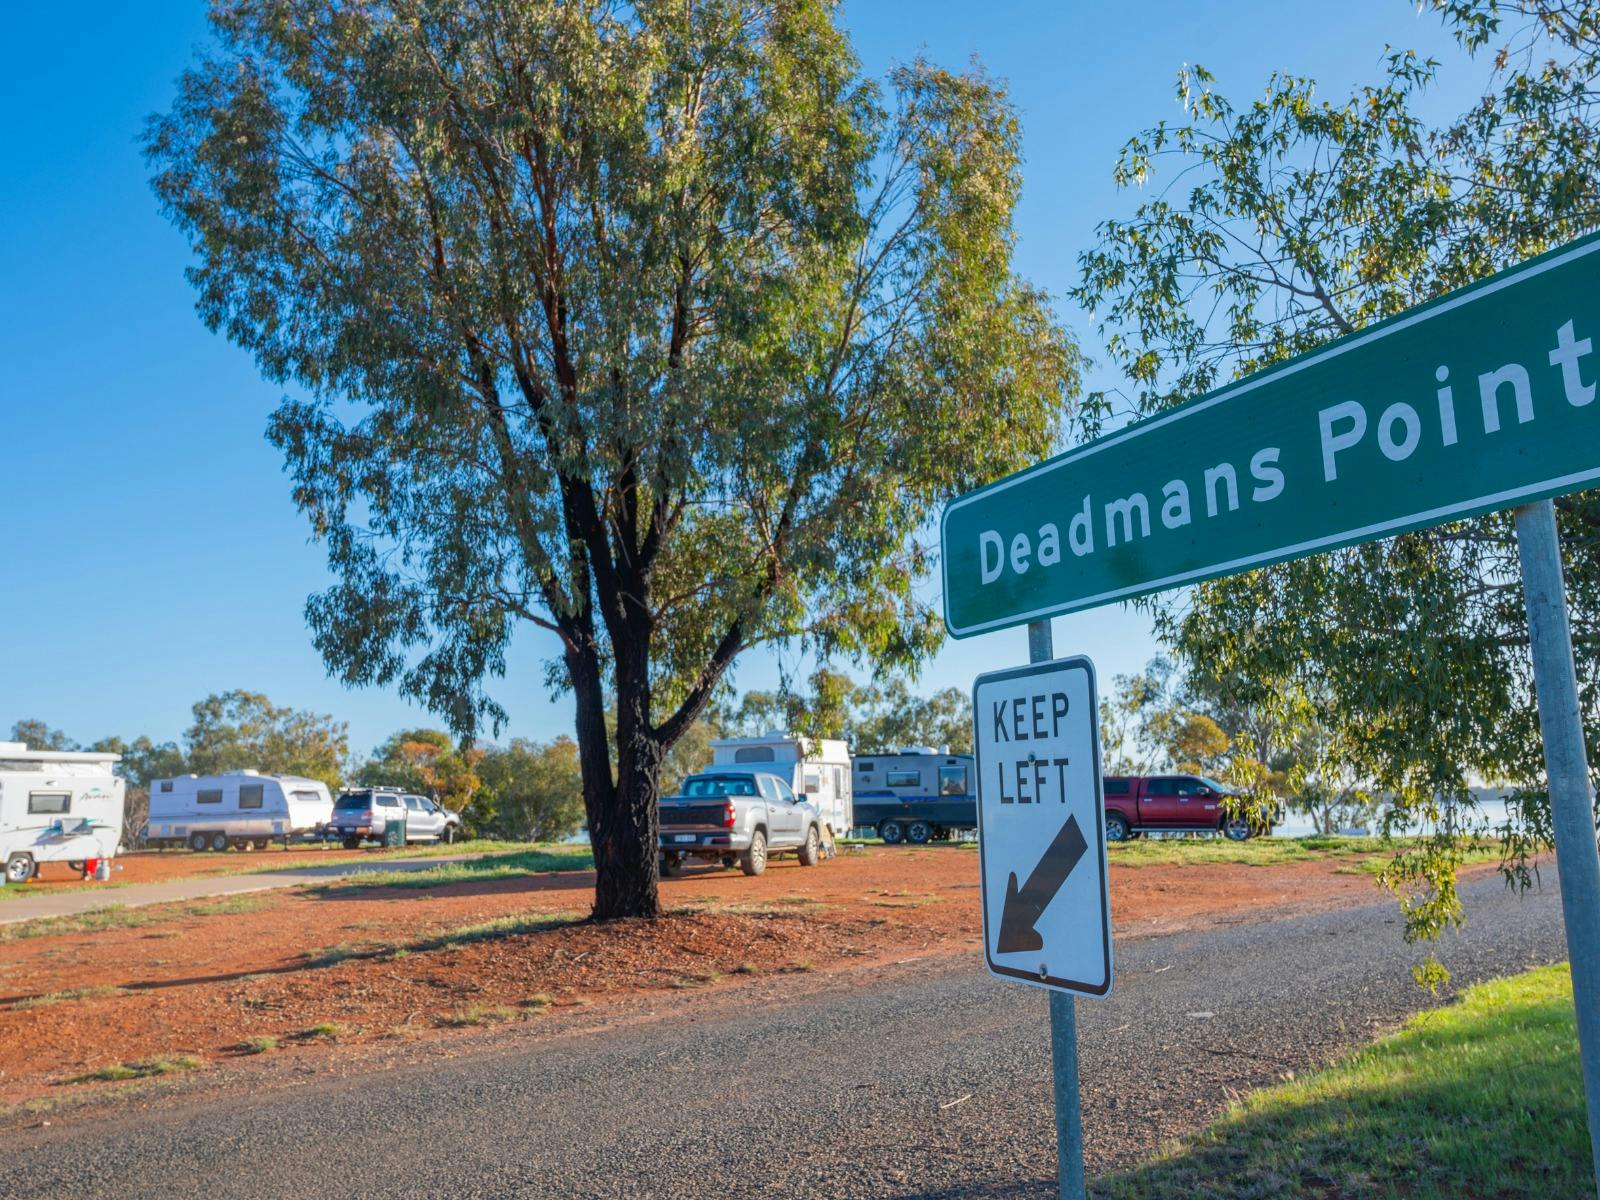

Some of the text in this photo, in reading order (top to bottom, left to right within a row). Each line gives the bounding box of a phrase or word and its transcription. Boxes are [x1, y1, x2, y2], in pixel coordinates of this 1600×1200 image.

[979, 318, 1598, 586] Deadmans Point
[993, 692, 1069, 743] KEEP
[998, 757, 1069, 804] LEFT
